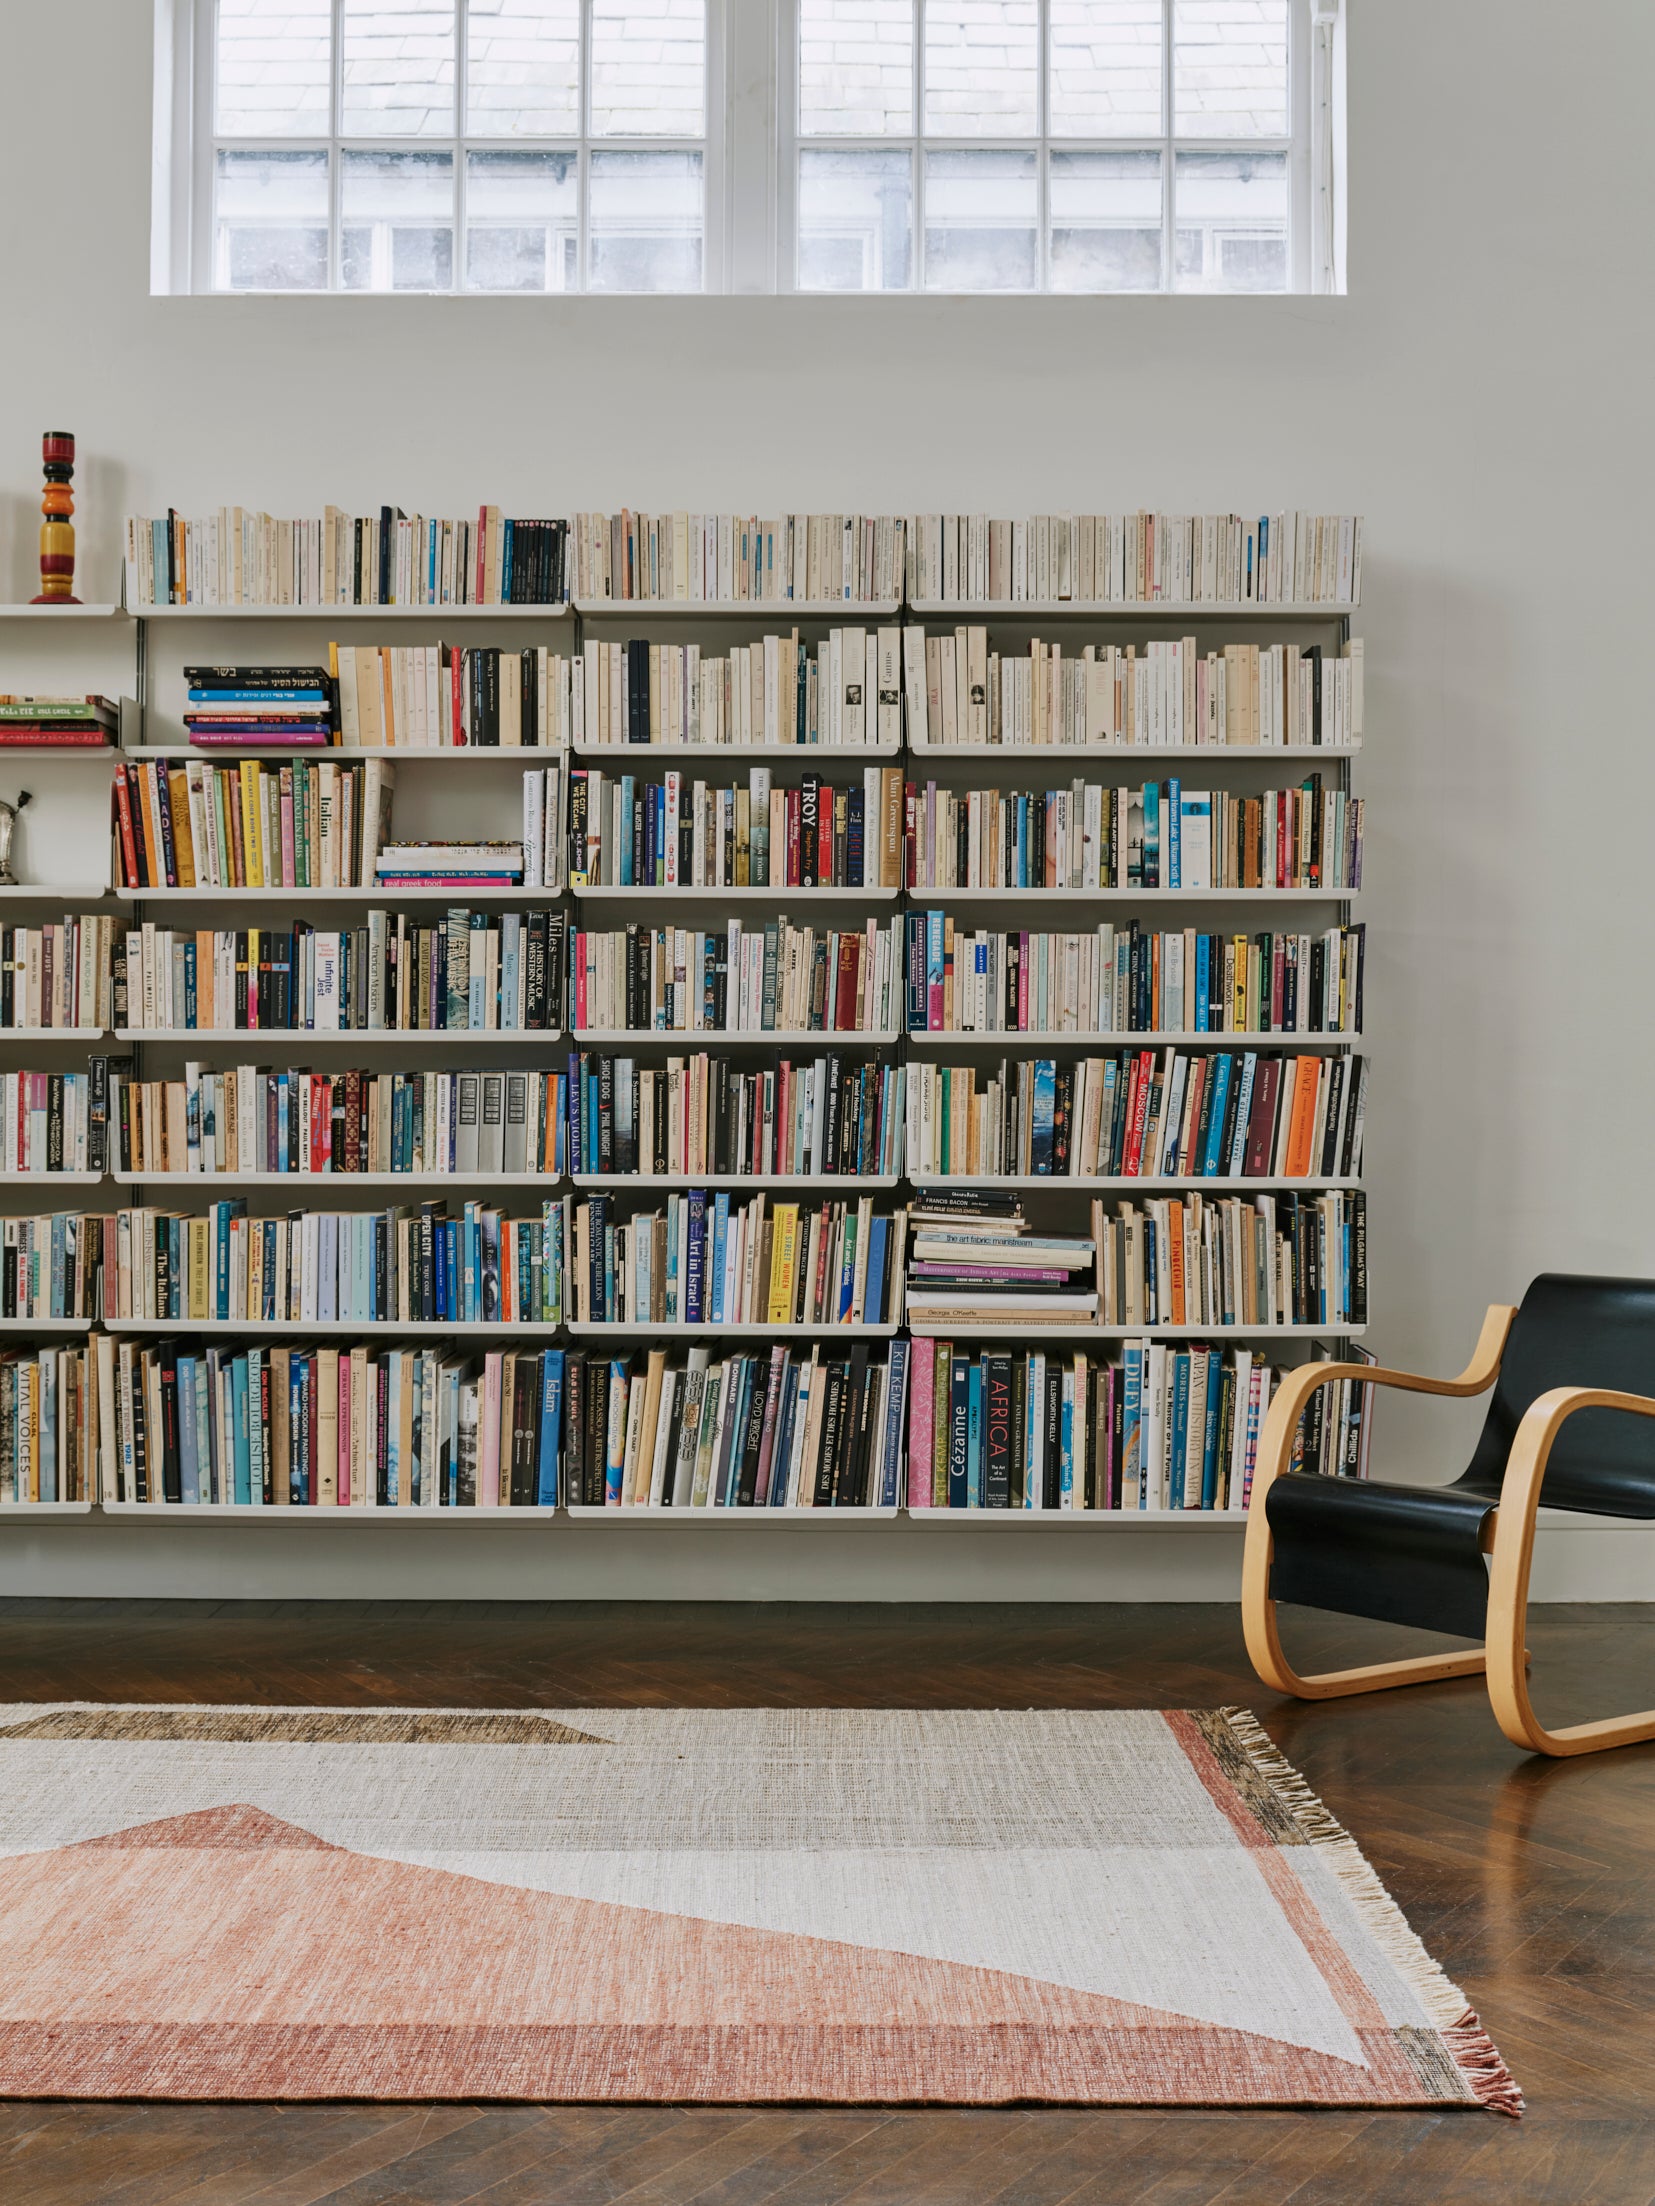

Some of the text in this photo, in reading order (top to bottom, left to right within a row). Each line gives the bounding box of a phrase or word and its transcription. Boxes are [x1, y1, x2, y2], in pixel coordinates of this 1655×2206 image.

[213, 668, 237, 677] בשר
[292, 679, 319, 687] הבישול
[158, 767, 170, 841] SALADS
[573, 787, 580, 797] WE
[296, 823, 301, 832] IN
[321, 797, 332, 837] Italian
[802, 780, 816, 870] TROY Stephen Fry
[886, 775, 900, 852] Alan Greenspan
[548, 914, 563, 953] Miles
[932, 918, 940, 963] RENEGADE
[325, 960, 334, 994] Infinite
[370, 943, 380, 1012] American Musicians
[528, 942, 536, 980] WESTERN
[317, 978, 326, 996] Jest
[536, 989, 543, 999] OF
[1226, 958, 1234, 1005] Deathwork
[602, 1060, 610, 1099] SHOE DOG
[1199, 1057, 1214, 1132] British Museum Guide
[1241, 1071, 1249, 1098] WATERS
[1301, 1062, 1313, 1095] GRACE
[571, 1084, 580, 1158] LEV'S VIOLIN
[1135, 1084, 1148, 1132] MOSCOW
[601, 1112, 610, 1156] PHIL KNIGHT
[19, 1224, 27, 1254] BURGESS
[422, 1215, 432, 1256] OPEN CITY
[717, 1198, 728, 1240] KIT KEMP
[782, 1213, 794, 1289] NINTH STREET WOMEN
[993, 1238, 1033, 1246] mainstream
[1357, 1230, 1365, 1270] PILGRIMS'
[158, 1253, 168, 1318] The Italians
[688, 1238, 701, 1306] Art in Israel
[714, 1274, 722, 1307] SECRETS
[121, 1350, 129, 1383] WORLD
[596, 1369, 605, 1392] PABLO
[729, 1364, 739, 1403] BONNARD
[890, 1351, 903, 1412] KIT KEMP
[1179, 1364, 1187, 1401] MORRIS
[1194, 1353, 1206, 1388] JAPAN
[545, 1379, 560, 1413] Islam
[1125, 1363, 1140, 1414] DUFY
[20, 1368, 30, 1473] VITAL VOICES
[249, 1353, 262, 1485] LOUISE BOURGEOIS
[596, 1394, 604, 1429] PICASSO:
[750, 1391, 764, 1451] LLOYD WRIGHT
[990, 1380, 1008, 1457] AFRICA
[1190, 1403, 1203, 1456] HISTORY
[821, 1381, 839, 1490] DES MODES ET DES HOMMES
[951, 1406, 966, 1476] Cézanne
[1166, 1432, 1172, 1440] OF
[1348, 1429, 1358, 1463] Chillida
[594, 1439, 602, 1502] RETROSPECTIVE
[1189, 1458, 1199, 1471] IN
[1187, 1474, 1199, 1496] ART
